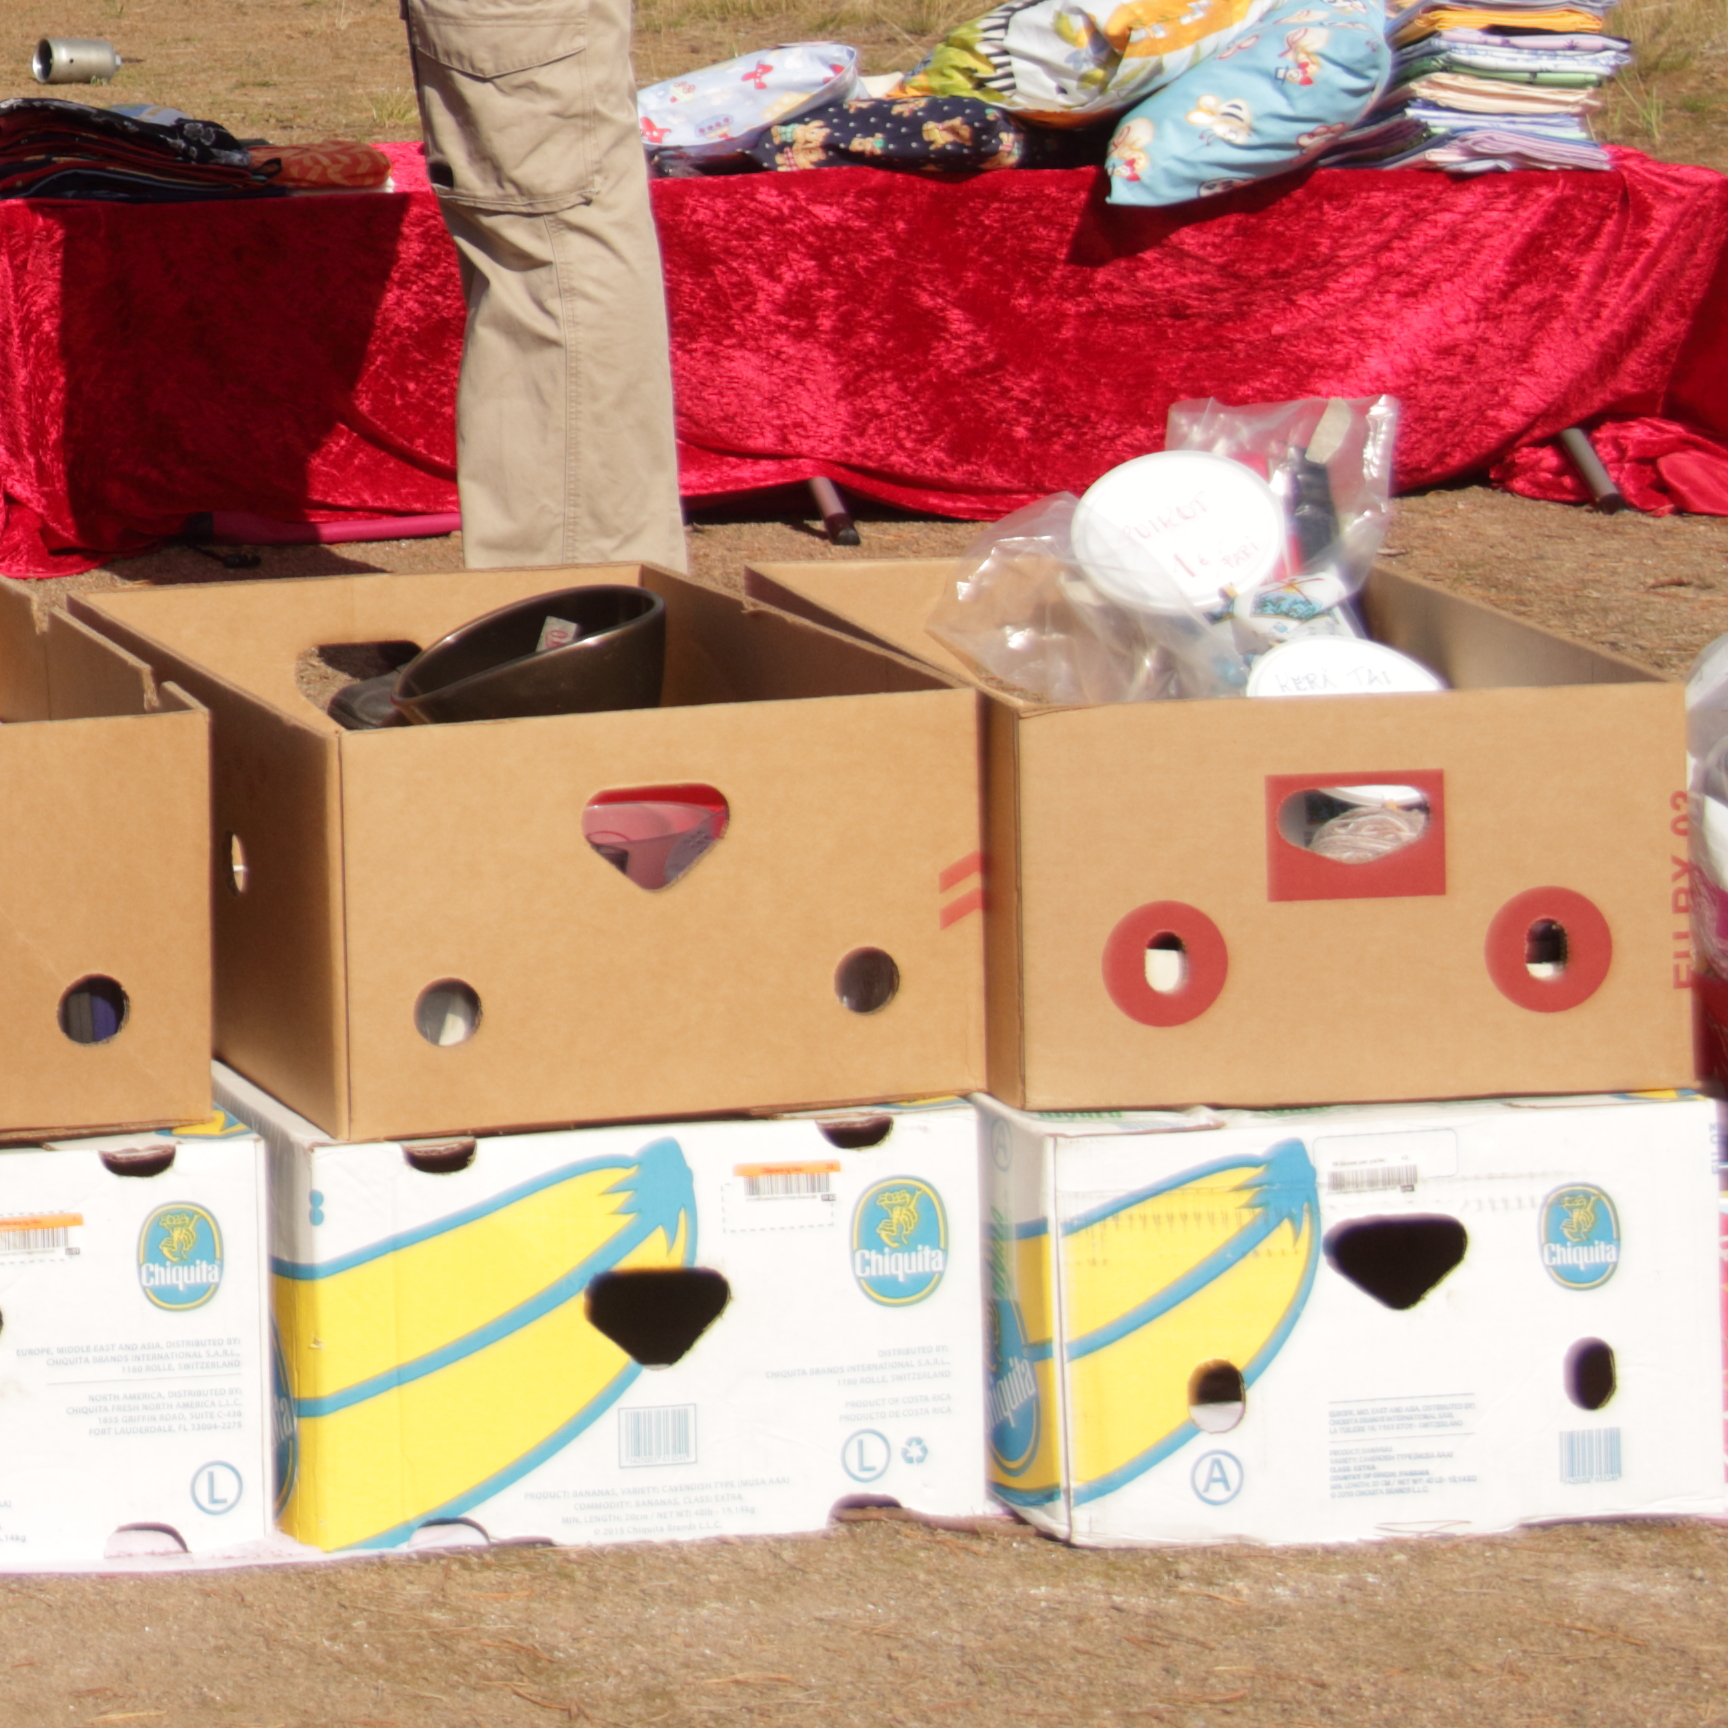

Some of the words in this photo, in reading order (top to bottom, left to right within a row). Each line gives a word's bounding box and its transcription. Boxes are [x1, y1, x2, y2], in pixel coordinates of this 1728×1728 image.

[853, 1246, 949, 1281] Chiquita
[1543, 1241, 1619, 1268] Chiquita
[141, 1259, 222, 1290] Chiquita
[16, 1347, 53, 1357] EUROPE,
[57, 1345, 90, 1355] MIDDLE
[94, 1344, 115, 1353] EAST
[118, 1343, 137, 1351] AND
[141, 1341, 163, 1350] ASIA,
[166, 1338, 224, 1349] DISTRIBUTED
[227, 1337, 240, 1346] BY:
[878, 1346, 932, 1357] DISTRIBUTED
[936, 1344, 948, 1353] BY:
[47, 1357, 89, 1367] CHIQUITA
[93, 1354, 128, 1364] BRANDS
[132, 1350, 202, 1362] INTERNATIONAL
[146, 1363, 175, 1372] ROLLE,
[178, 1359, 240, 1371] SWITZERLAND
[766, 1368, 806, 1379] CHIQUITA
[810, 1365, 844, 1375] BRANDS
[847, 1360, 914, 1372] INTERNATIONAL
[860, 1375, 887, 1385] ROLLE,
[891, 1370, 950, 1382] SWITZERLAND
[89, 1393, 119, 1403] NORTH
[123, 1391, 165, 1401] AMERICA,
[168, 1388, 225, 1399] DISTRIBUTED
[229, 1387, 241, 1396] BY:
[845, 1398, 886, 1409] PRODUCT
[889, 1397, 899, 1405] OF
[902, 1394, 929, 1404] COSTA
[932, 1393, 951, 1401] RICA
[66, 1405, 108, 1415] CHIQUITA
[112, 1404, 139, 1413] FRESH
[142, 1402, 173, 1411] NORTH
[176, 1399, 215, 1409] AMERICA
[840, 1411, 886, 1422] PRODUCTO
[889, 1410, 900, 1418] DE
[902, 1407, 929, 1417] COSTA
[932, 1405, 951, 1414] RICA
[122, 1414, 156, 1423] GRIFFIN
[159, 1412, 186, 1421] ROAD,
[190, 1411, 214, 1420] SUITE
[89, 1427, 111, 1436] FORT
[115, 1424, 175, 1434] LAUDERDALE,
[178, 1423, 188, 1432] FL
[857, 1441, 877, 1472] L
[1205, 1460, 1230, 1495] A
[208, 1470, 227, 1506] L
[525, 1490, 570, 1500] PRODUCT:
[573, 1487, 615, 1497] BANANAS,
[621, 1484, 659, 1494] VARIETY:
[662, 1481, 711, 1492] CAVENDISH
[715, 1480, 734, 1488] TYPE
[738, 1478, 765, 1488] (MUSA
[769, 1476, 790, 1486] AAA)
[574, 1499, 632, 1511] COMMODITY:
[635, 1496, 680, 1507] BANANAS,
[683, 1494, 712, 1504] CLASS:
[715, 1492, 742, 1501] EXTRA
